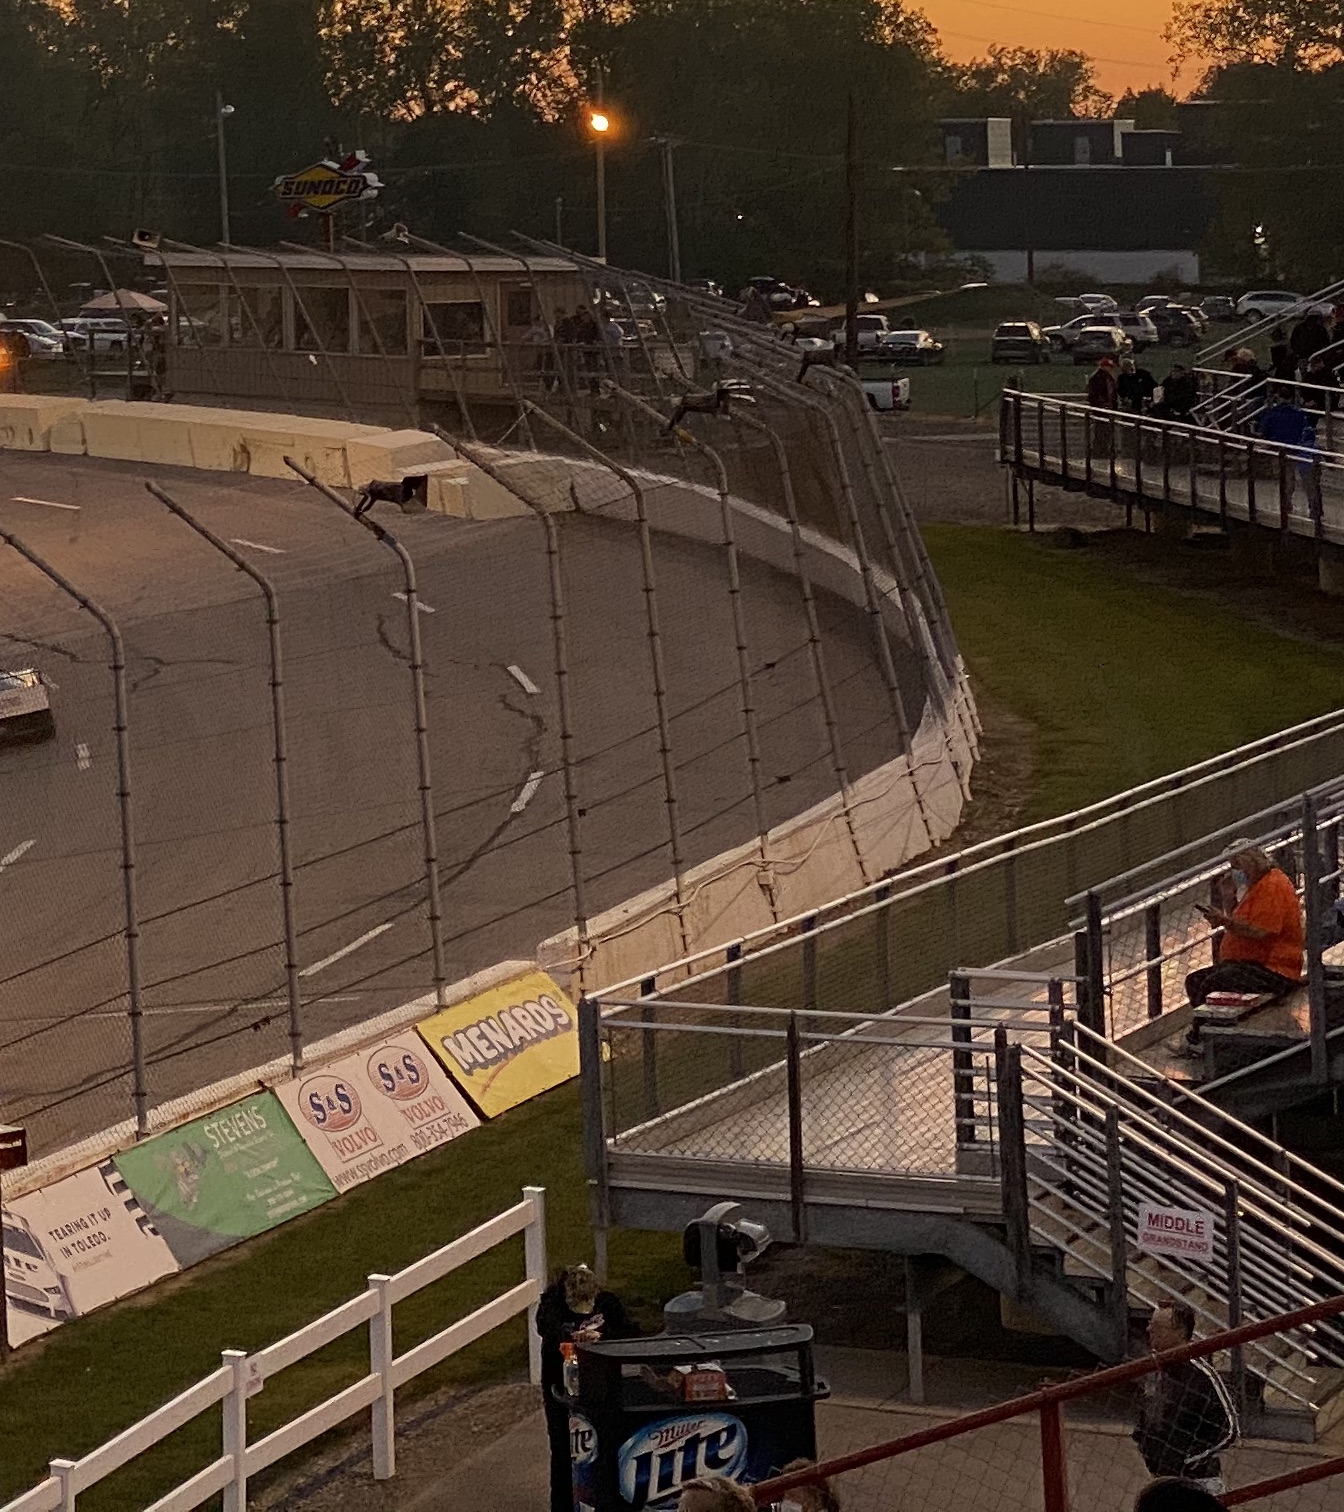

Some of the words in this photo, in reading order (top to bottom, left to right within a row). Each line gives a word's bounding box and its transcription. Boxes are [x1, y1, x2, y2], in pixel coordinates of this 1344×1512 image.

[282, 179, 361, 196] SUNOCO
[440, 994, 572, 1076] MENARDS
[402, 1095, 446, 1124] VOLVO
[203, 1106, 267, 1148] STEVENS
[332, 1126, 378, 1157] VOLVO
[48, 1216, 89, 1243] TEARING
[89, 1212, 100, 1226] IT
[100, 1207, 112, 1220] UP
[1147, 1212, 1204, 1235] MIDDLE
[60, 1246, 73, 1259] IN
[74, 1231, 112, 1254] TOLEDO.
[649, 1419, 708, 1448] Miller
[632, 1423, 738, 1509] Lite
